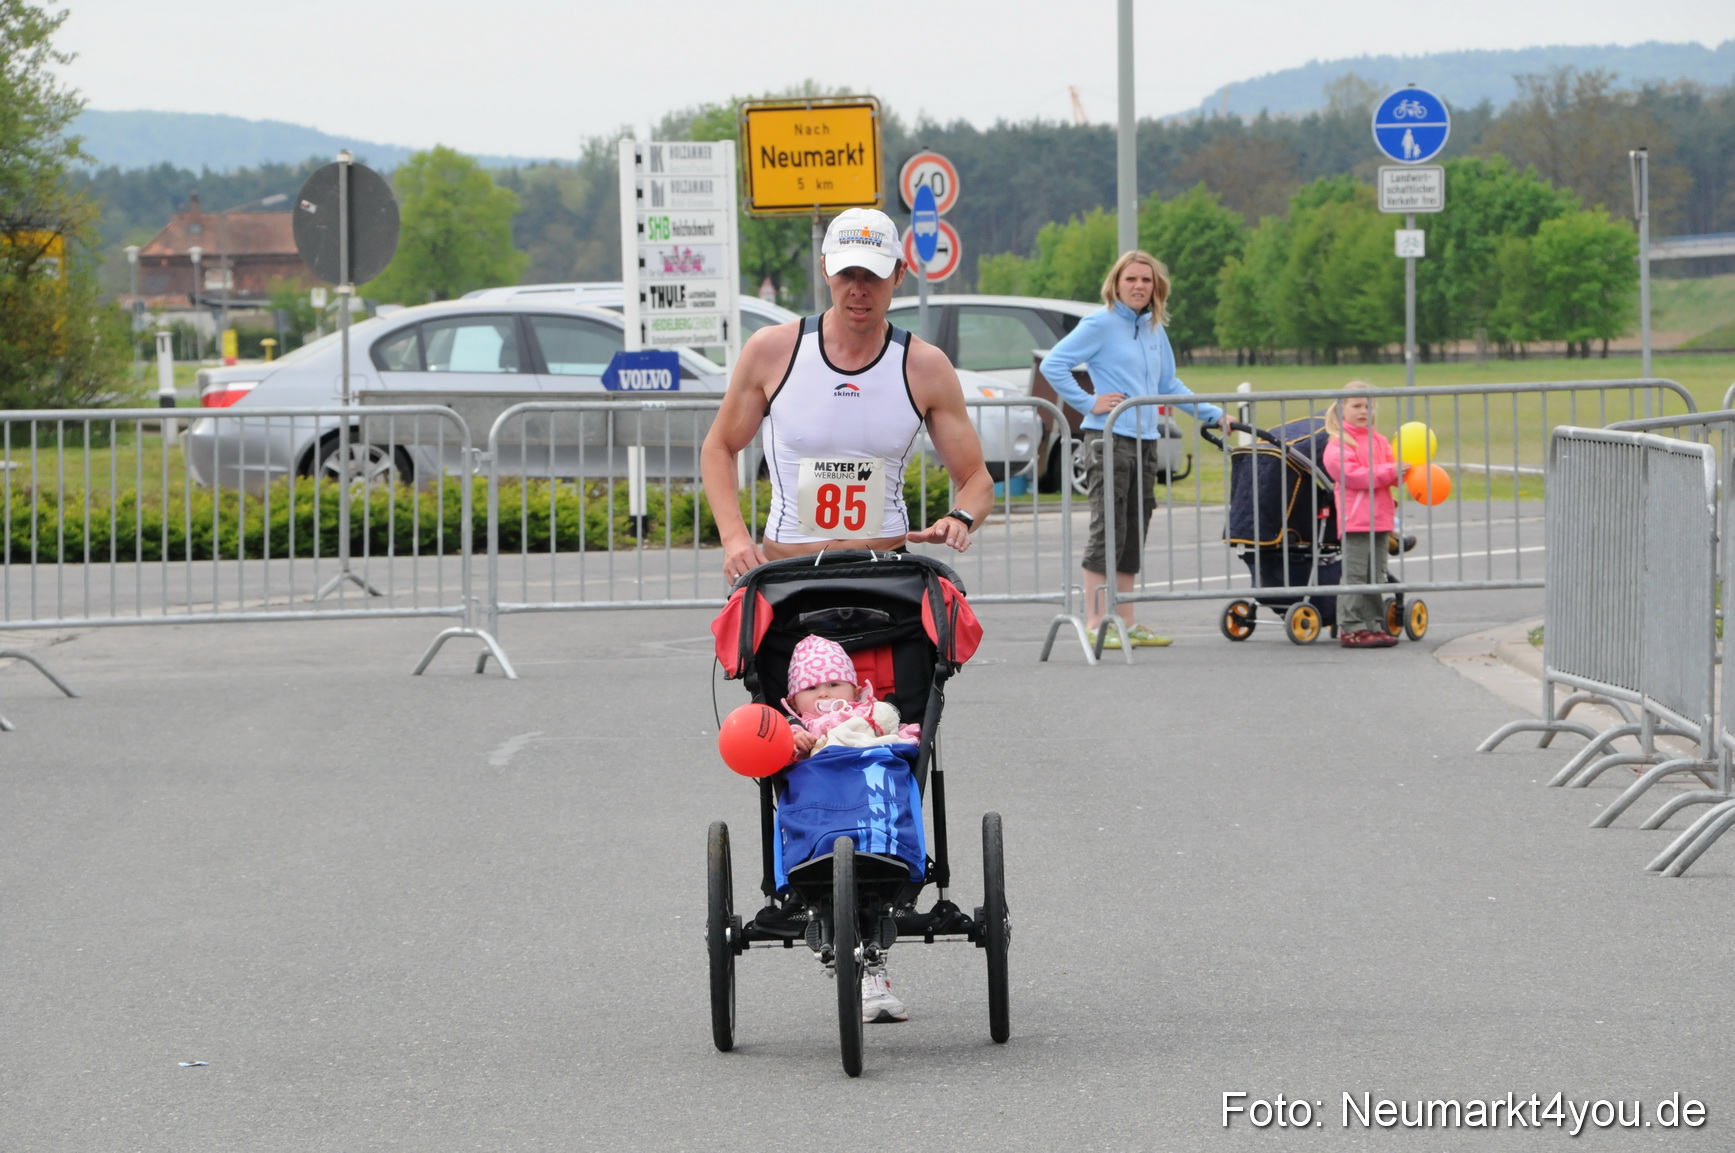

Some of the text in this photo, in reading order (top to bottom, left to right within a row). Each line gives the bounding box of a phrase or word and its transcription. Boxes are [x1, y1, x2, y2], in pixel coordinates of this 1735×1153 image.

[794, 123, 830, 136] Nach
[760, 142, 866, 169] Neumarkt
[796, 177, 834, 190] 5 km
[648, 216, 671, 240] SHB
[838, 226, 884, 241] IRONMAN
[839, 239, 882, 248] WETSUITS
[650, 285, 686, 309] THULE
[618, 368, 672, 390] VOLVO
[833, 390, 860, 398] skinfit
[814, 462, 855, 472] MEYER
[814, 472, 855, 480] WERBUNG
[815, 483, 867, 531] 85
